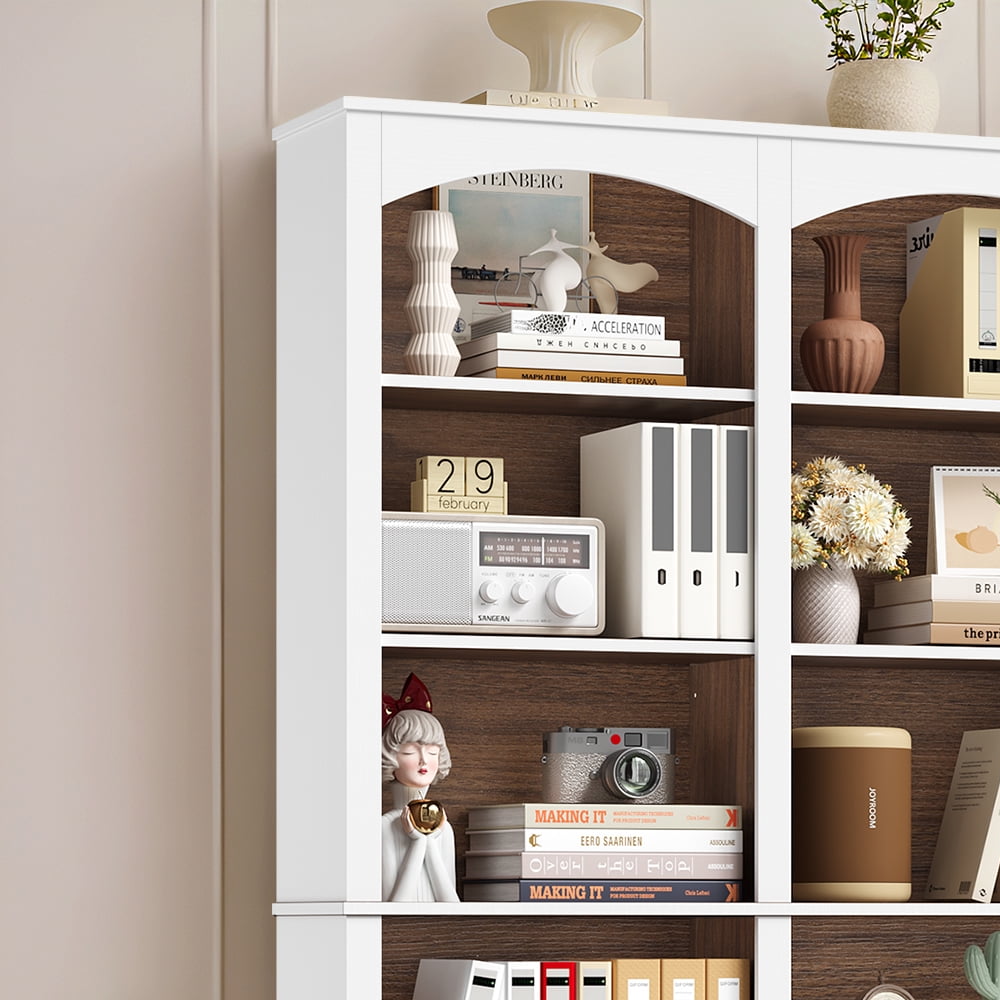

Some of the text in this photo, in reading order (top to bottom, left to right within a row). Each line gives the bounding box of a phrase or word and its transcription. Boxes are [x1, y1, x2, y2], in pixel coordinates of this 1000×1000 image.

[468, 172, 563, 189] STEINBERG
[591, 320, 662, 336] ACCELERATION
[521, 373, 658, 386] МАРК ЛЕВИ СИЛЬНЕЕ СТРАХА
[438, 496, 490, 512] february
[868, 787, 877, 829] JOYROOM
[535, 810, 607, 824] MAKING IT
[580, 836, 643, 847] EERO SAARINEN
[529, 885, 604, 900] MAKING IT
